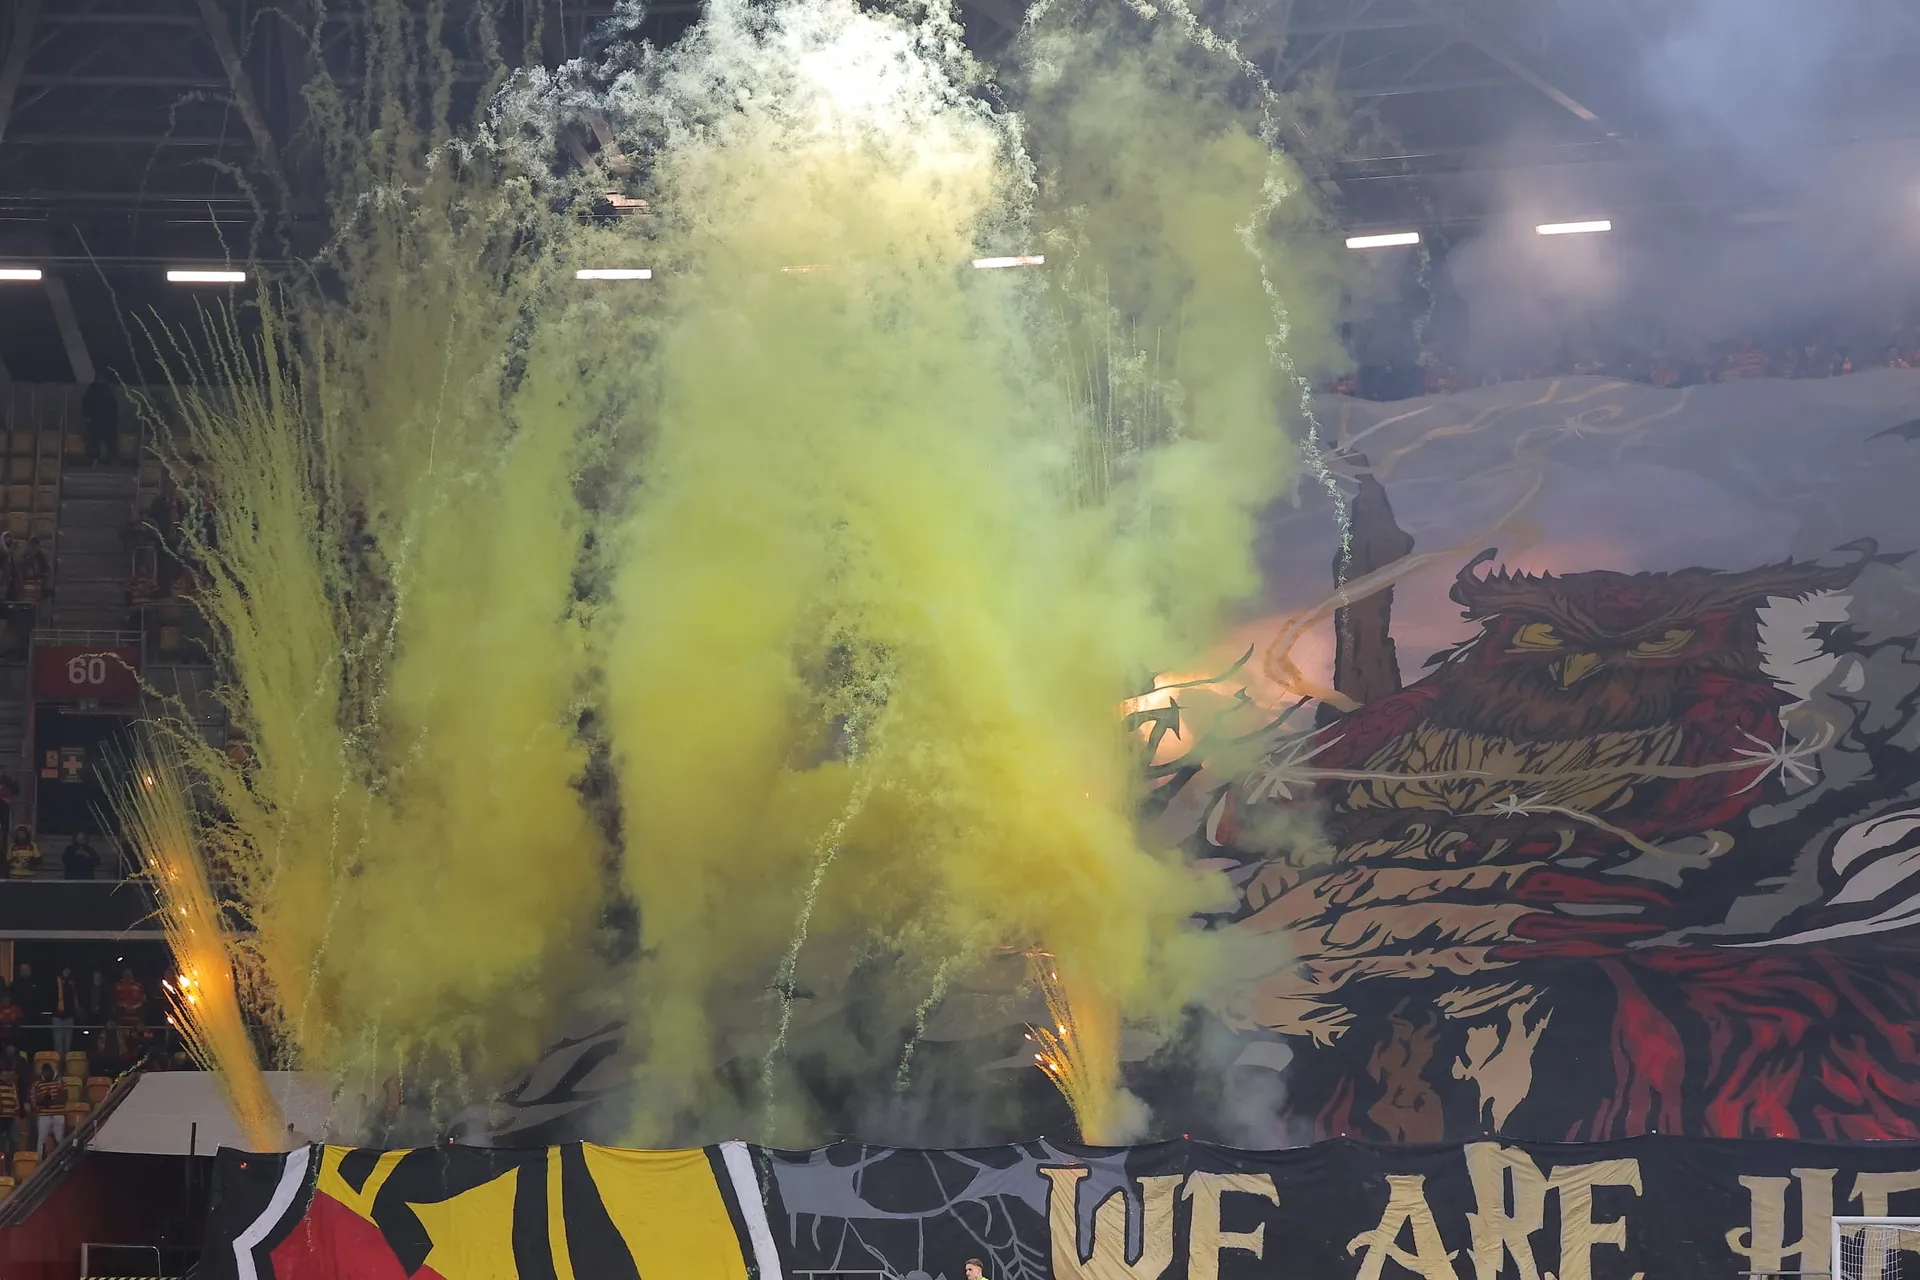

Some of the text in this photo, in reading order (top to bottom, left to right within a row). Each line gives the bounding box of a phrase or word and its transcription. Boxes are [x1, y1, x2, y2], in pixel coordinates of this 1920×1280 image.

[68, 657, 106, 684] 60
[1039, 1168, 1280, 1280] WE
[1346, 1141, 1643, 1280] ARE
